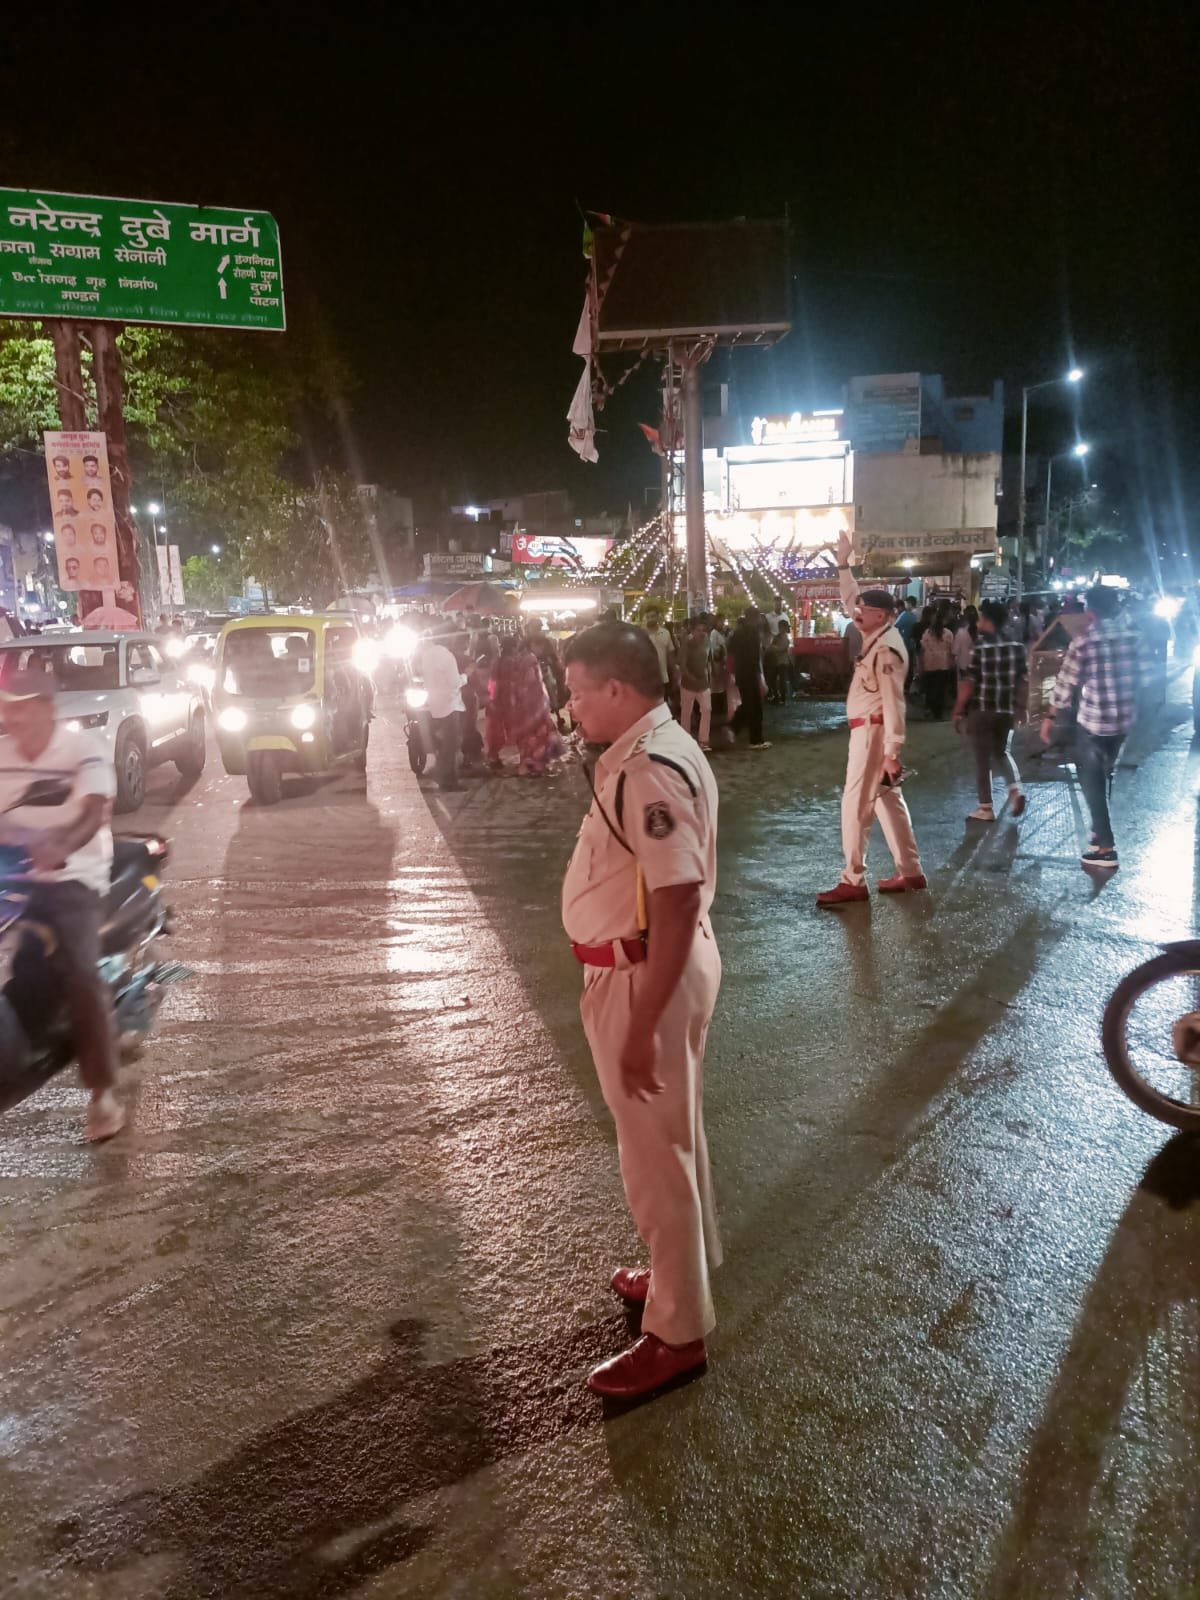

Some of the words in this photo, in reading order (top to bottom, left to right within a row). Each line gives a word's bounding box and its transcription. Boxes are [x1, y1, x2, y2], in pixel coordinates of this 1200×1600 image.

[8, 198, 103, 238] नरेन्द्र
[120, 209, 171, 248] दुबे
[189, 217, 261, 248] मार्ग
[113, 244, 167, 267] सेनानी
